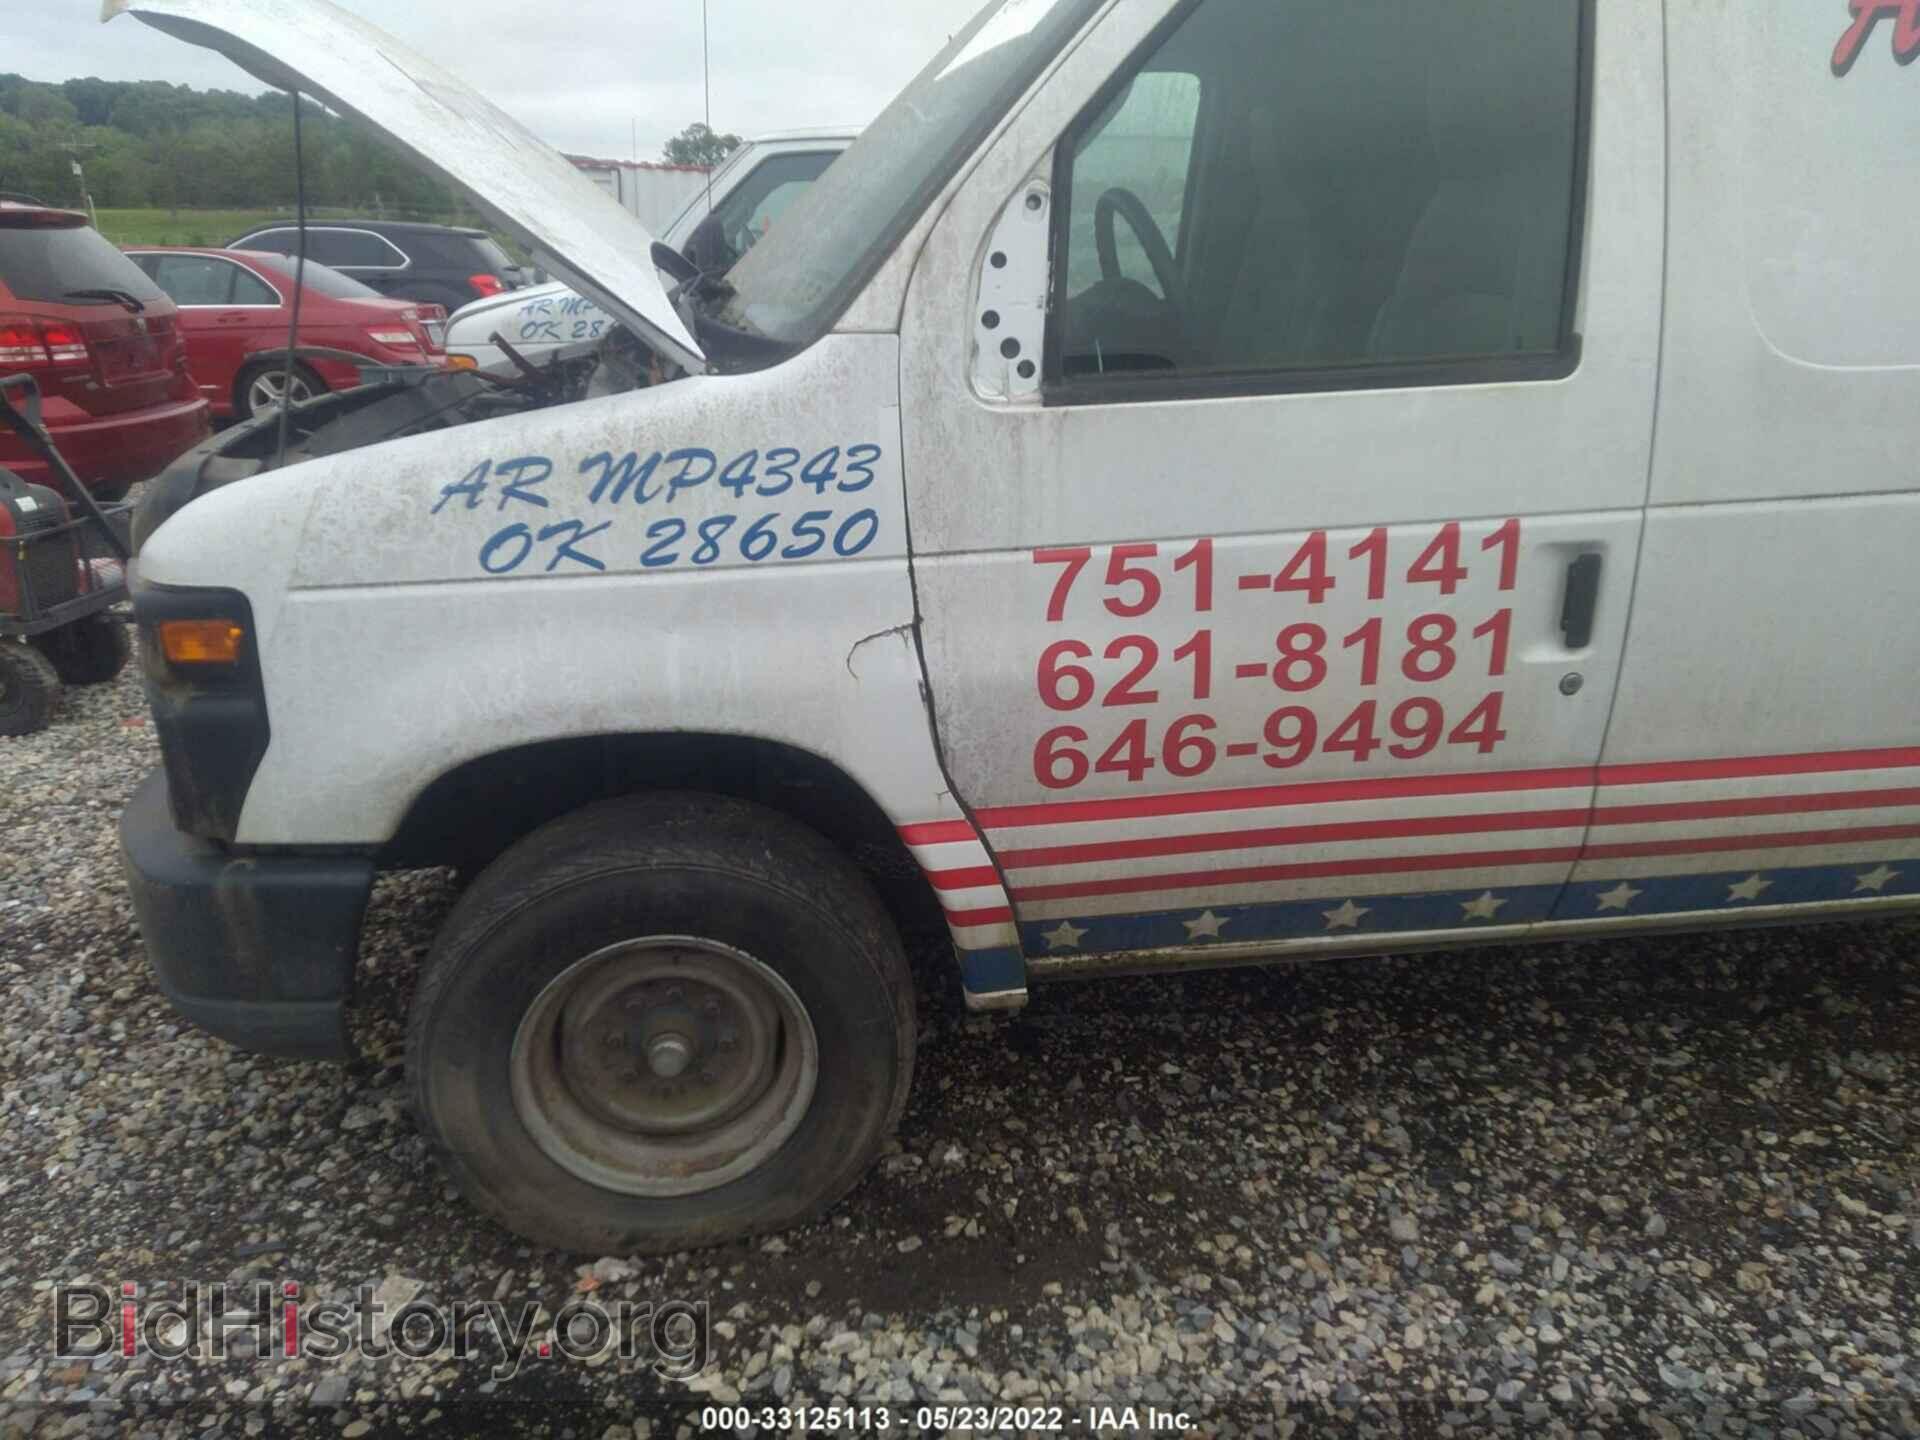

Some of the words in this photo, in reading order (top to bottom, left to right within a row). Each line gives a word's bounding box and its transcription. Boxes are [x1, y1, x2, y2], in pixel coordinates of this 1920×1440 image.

[520, 319, 562, 340] OK
[431, 456, 553, 514] AR
[579, 443, 882, 505] MP4343
[479, 519, 612, 574] OK
[640, 508, 880, 568] 28650
[1032, 517, 1521, 622] 751-4141
[1036, 607, 1513, 712] 621-8181
[1032, 690, 1508, 790] 646-9494
